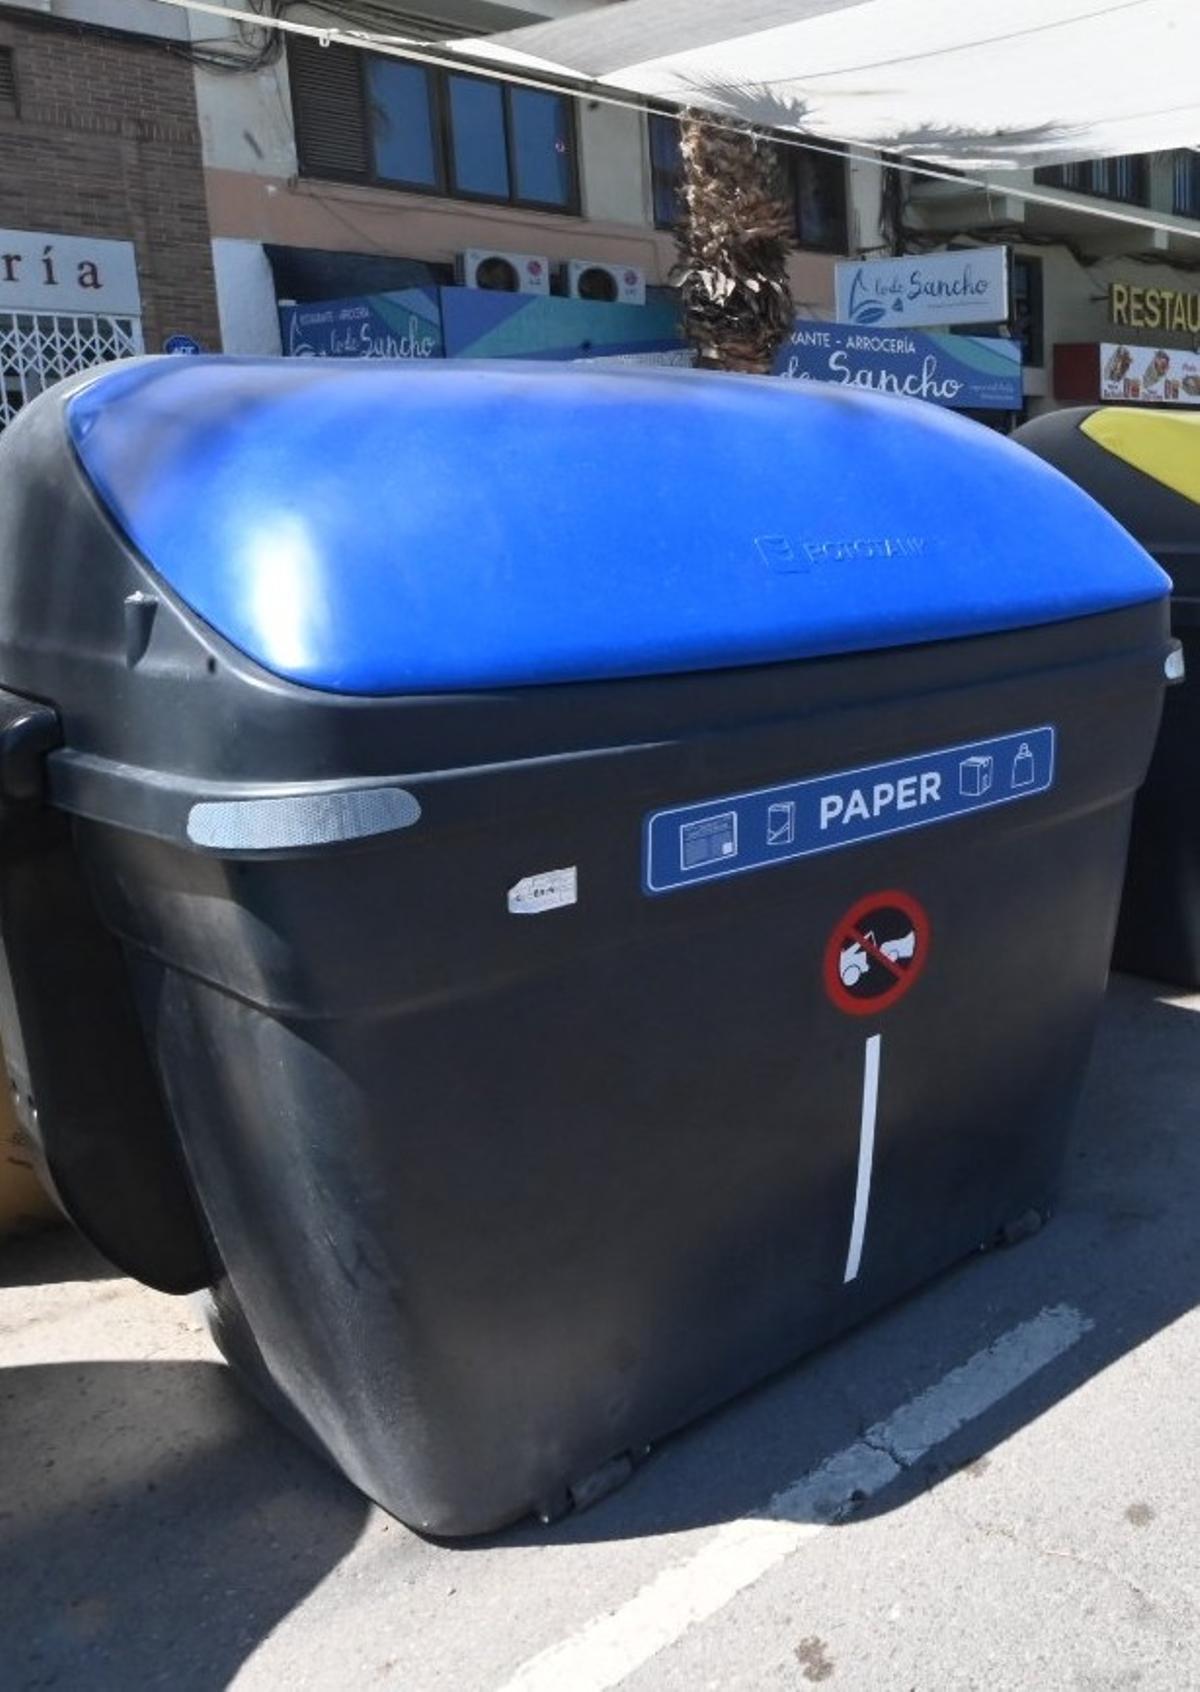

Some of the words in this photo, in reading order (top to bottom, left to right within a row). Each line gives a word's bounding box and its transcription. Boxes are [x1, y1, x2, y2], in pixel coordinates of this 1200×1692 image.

[907, 264, 990, 300] Sancho
[1112, 283, 1200, 333] RESTAU
[360, 314, 436, 359] Sancho
[846, 335, 916, 354] ARROCERÍA
[828, 350, 964, 398] Sancho
[819, 771, 942, 830] PAPER
